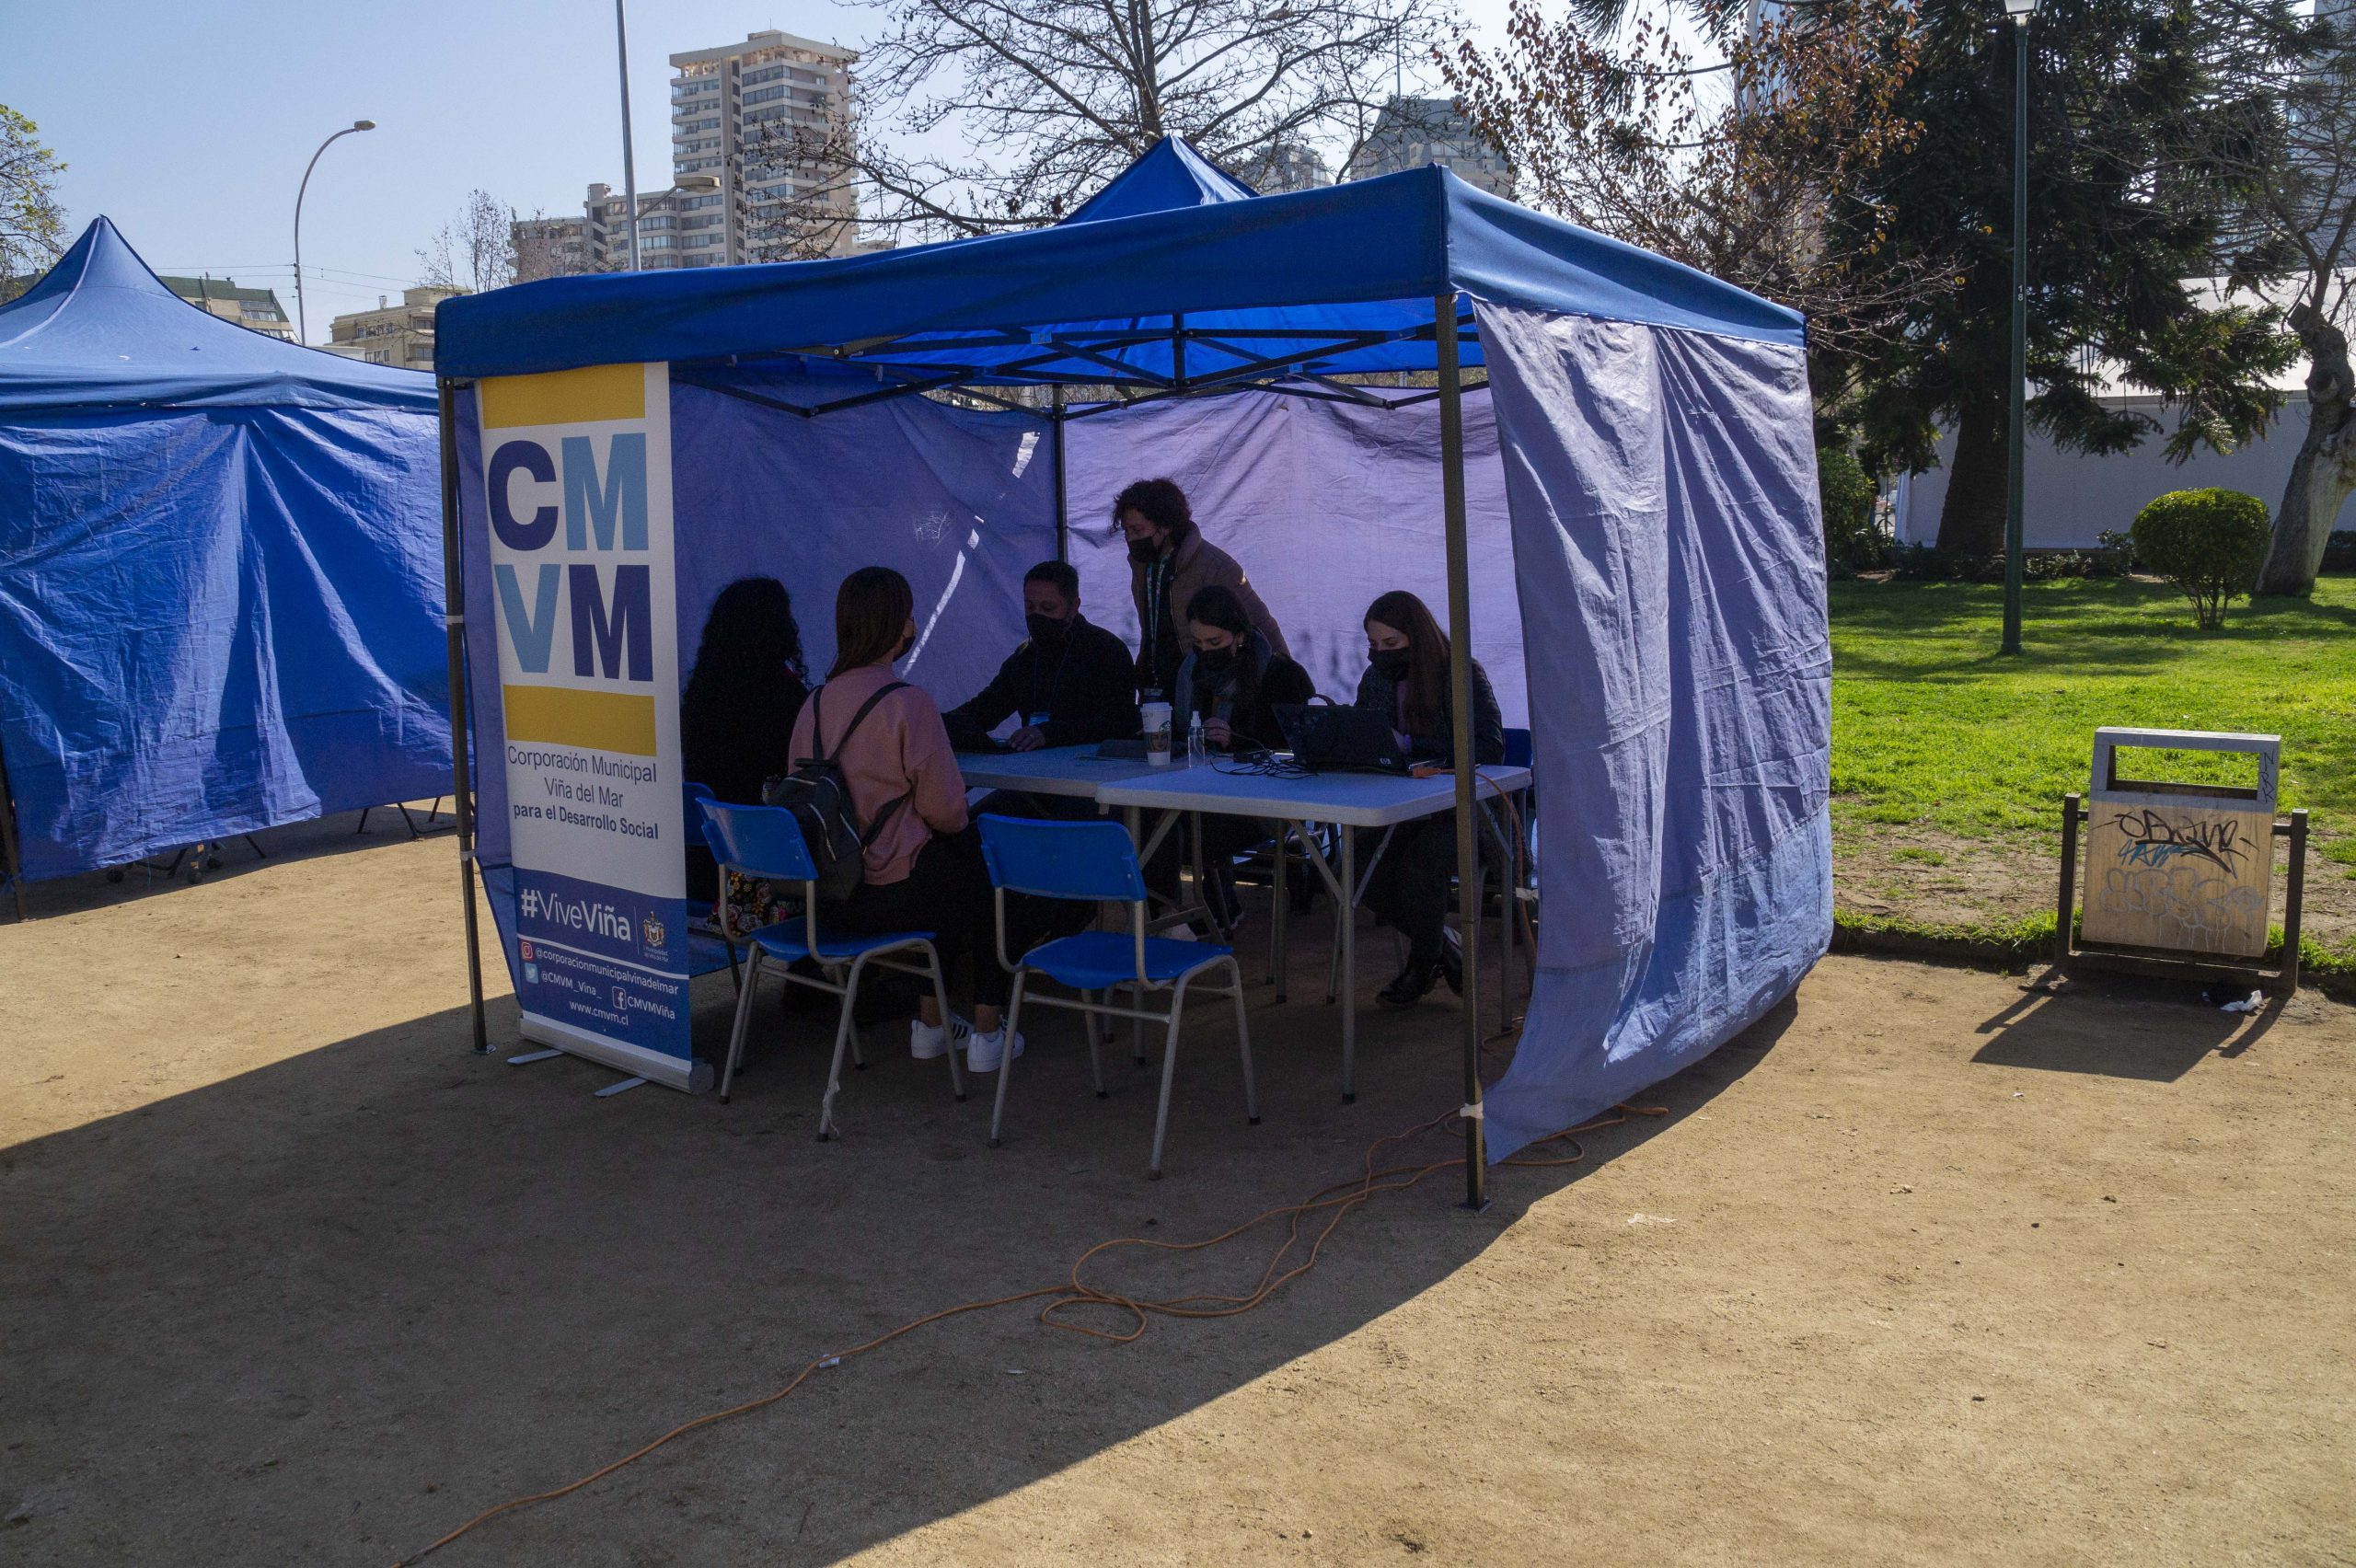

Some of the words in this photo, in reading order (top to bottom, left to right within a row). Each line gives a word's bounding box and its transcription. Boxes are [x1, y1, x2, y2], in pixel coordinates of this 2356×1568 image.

[489, 432, 649, 551] CM
[494, 564, 653, 682] VM
[508, 746, 588, 772] Corporación
[592, 755, 657, 785] Municipal
[545, 778, 572, 799] Viña
[576, 783, 595, 802] del
[598, 786, 623, 808] Mar
[514, 804, 541, 819] para
[546, 805, 556, 820] el
[560, 806, 617, 832] Desarrollo
[620, 818, 659, 839] Social
[521, 888, 631, 941] #ViveViña
[536, 947, 678, 995] @corporacionmunicipalvinadelmar
[569, 1000, 629, 1026] www.cmvm.cl
[628, 997, 676, 1020] CMVMViña
